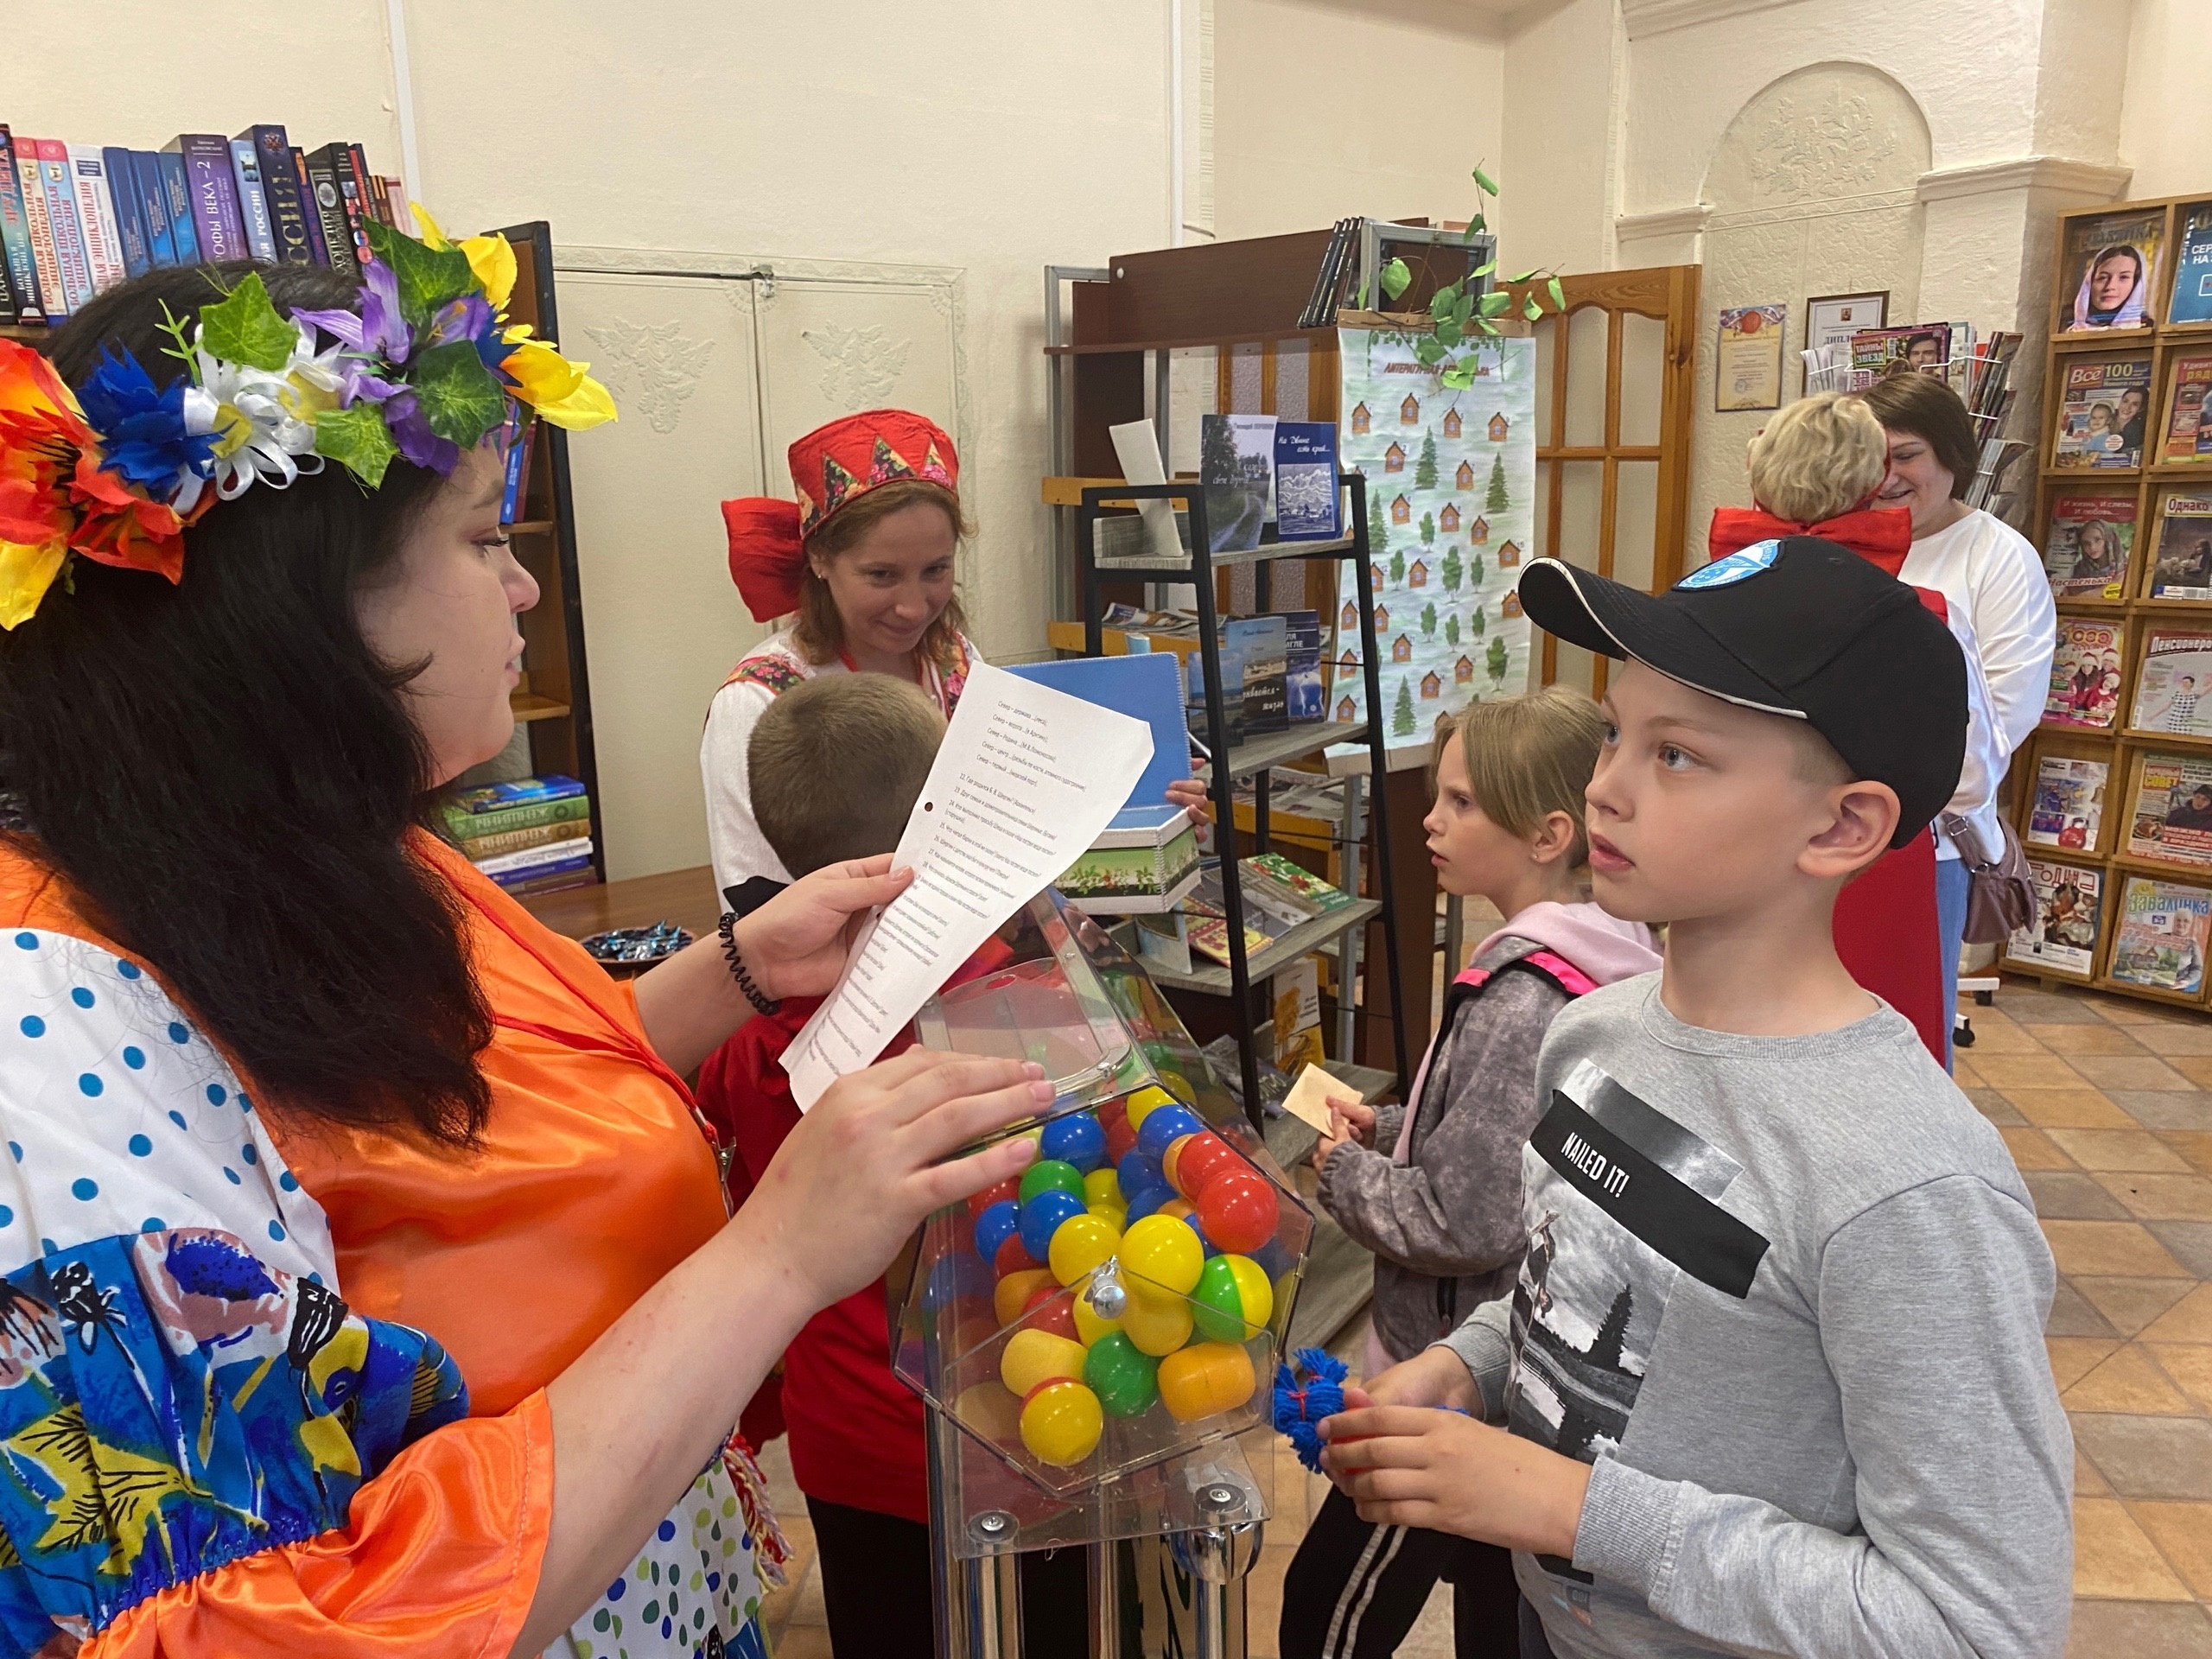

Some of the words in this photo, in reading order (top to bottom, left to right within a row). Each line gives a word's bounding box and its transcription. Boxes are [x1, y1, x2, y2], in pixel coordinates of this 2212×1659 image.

[202, 181, 219, 214] ВЕКА
[23, 182, 43, 247] ШКОЛЬНАЯ
[48, 186, 69, 249] ШКОЛЬНАЯ
[79, 181, 107, 262] ЭНЦИКЛОПЕДИЯ
[250, 190, 268, 236] РОССИИ
[35, 197, 60, 289] ЭНЦИКЛОПЕДИЯ
[62, 199, 87, 291] ЭНЦИКЛОПЕДИЯ
[1824, 335, 1851, 345] ДИПЛ
[1855, 343, 1884, 353] ТАЙНЫ
[1856, 353, 1884, 363] ЗВЕЗД
[2070, 369, 2101, 384] Все
[2105, 364, 2133, 378] 100
[2169, 498, 2209, 512] Однако
[2049, 575, 2113, 586] Настенька
[998, 701, 1011, 710] Север
[993, 715, 1006, 723] Север
[988, 728, 1001, 737] Север
[982, 741, 995, 751] Север
[976, 754, 989, 764] Север
[2128, 893, 2209, 915] Завалинка
[1560, 1131, 1607, 1181] NAILED
[1603, 1165, 1630, 1198] IT!
